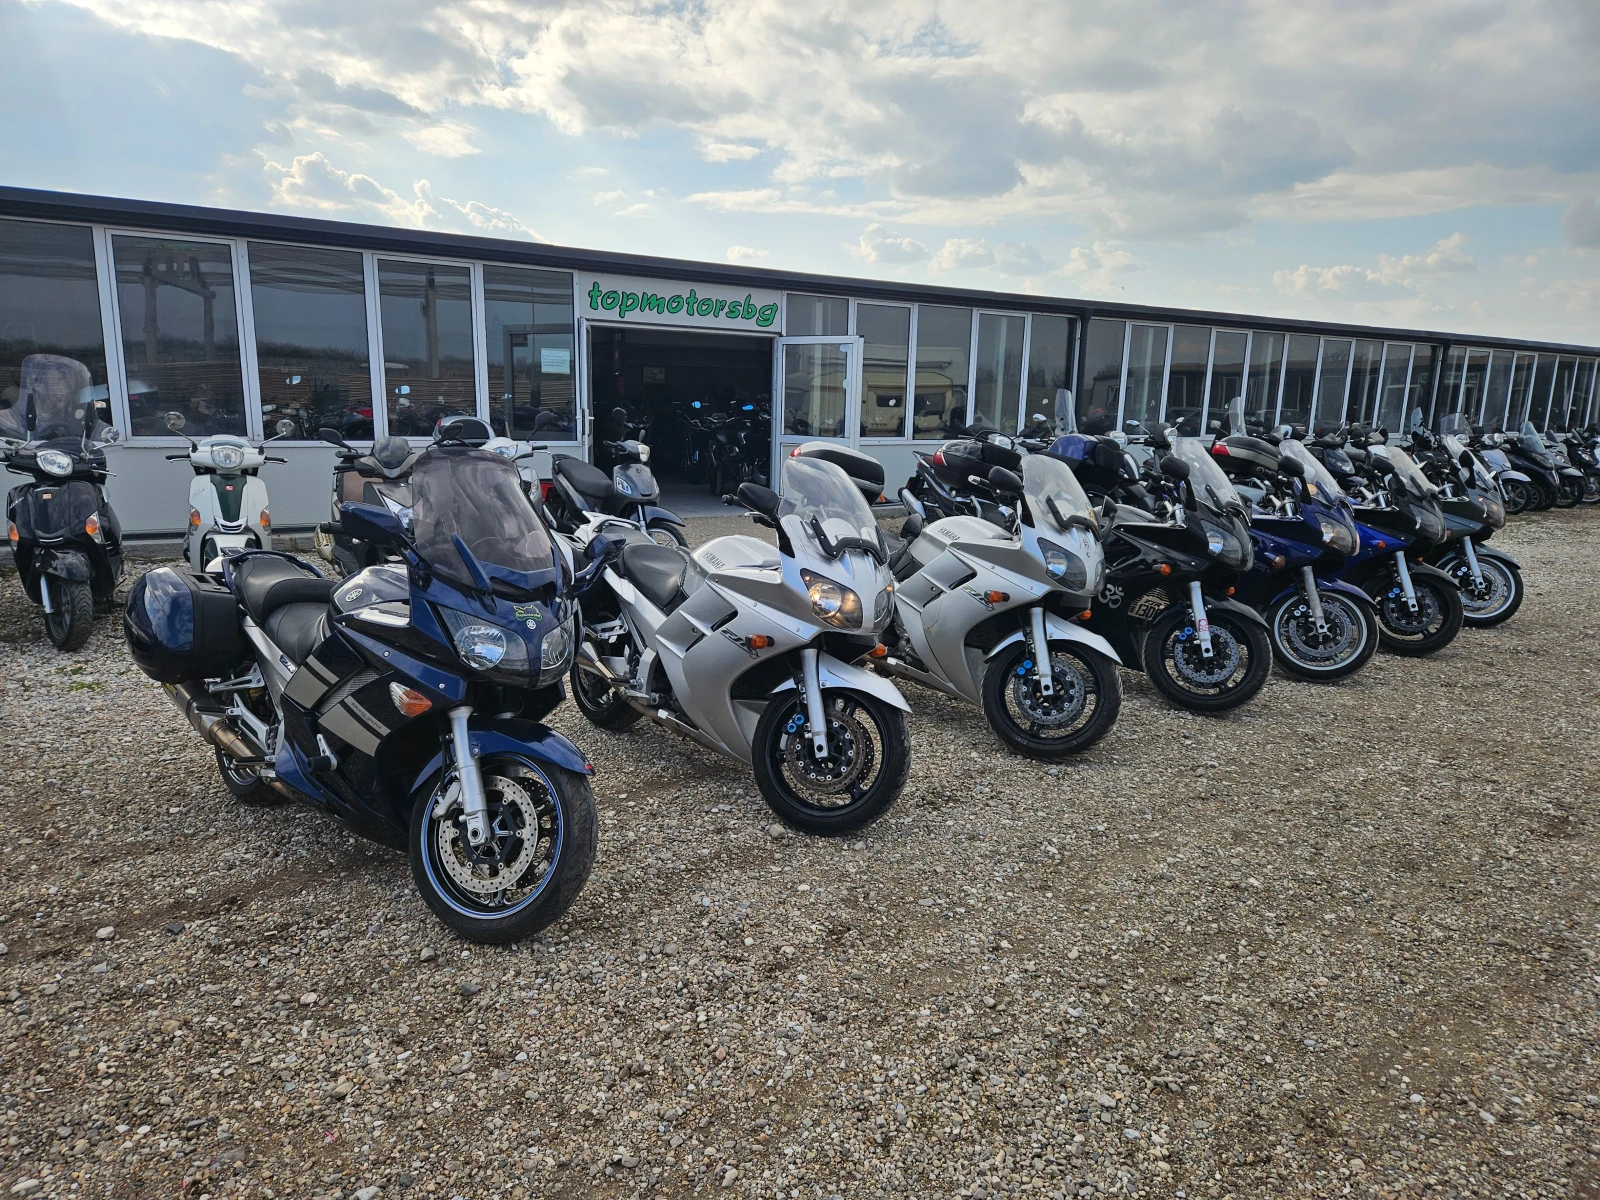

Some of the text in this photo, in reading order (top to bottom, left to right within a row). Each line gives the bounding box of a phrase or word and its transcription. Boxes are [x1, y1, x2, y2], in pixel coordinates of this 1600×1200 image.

[588, 281, 778, 327] topmotorsbg
[938, 527, 960, 541] YAMAHA
[703, 551, 725, 571] YAMAHA
[1144, 599, 1162, 607] FJR
